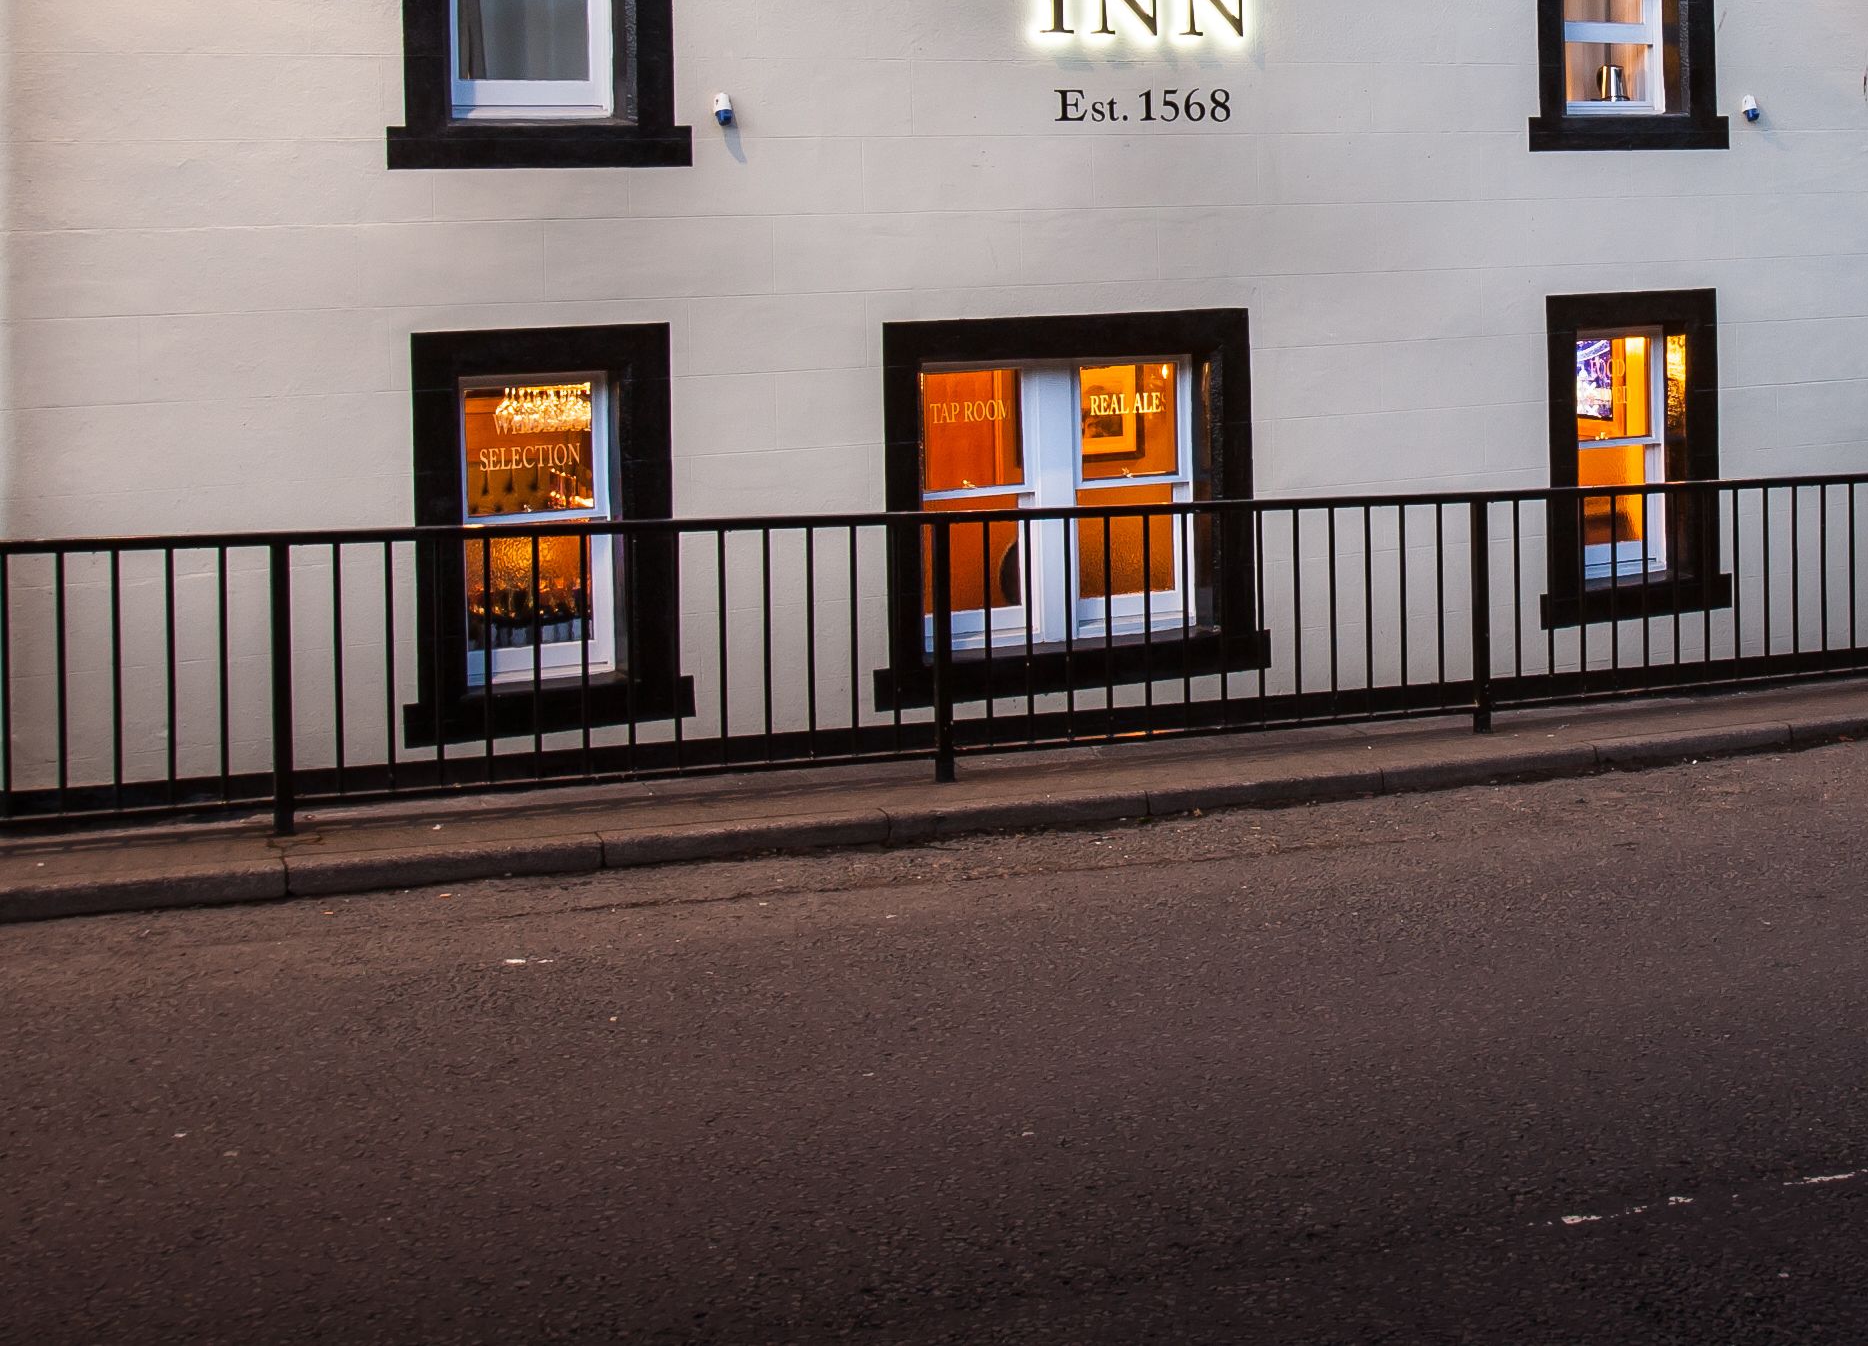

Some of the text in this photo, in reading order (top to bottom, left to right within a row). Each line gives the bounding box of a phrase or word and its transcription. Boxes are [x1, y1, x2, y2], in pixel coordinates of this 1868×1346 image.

[1054, 88, 1231, 122] Est. 1568
[1590, 358, 1626, 379] FOOD
[929, 399, 1011, 424] TAP ROOM
[1090, 394, 1130, 416] REAL
[479, 443, 580, 471] SELECTION
